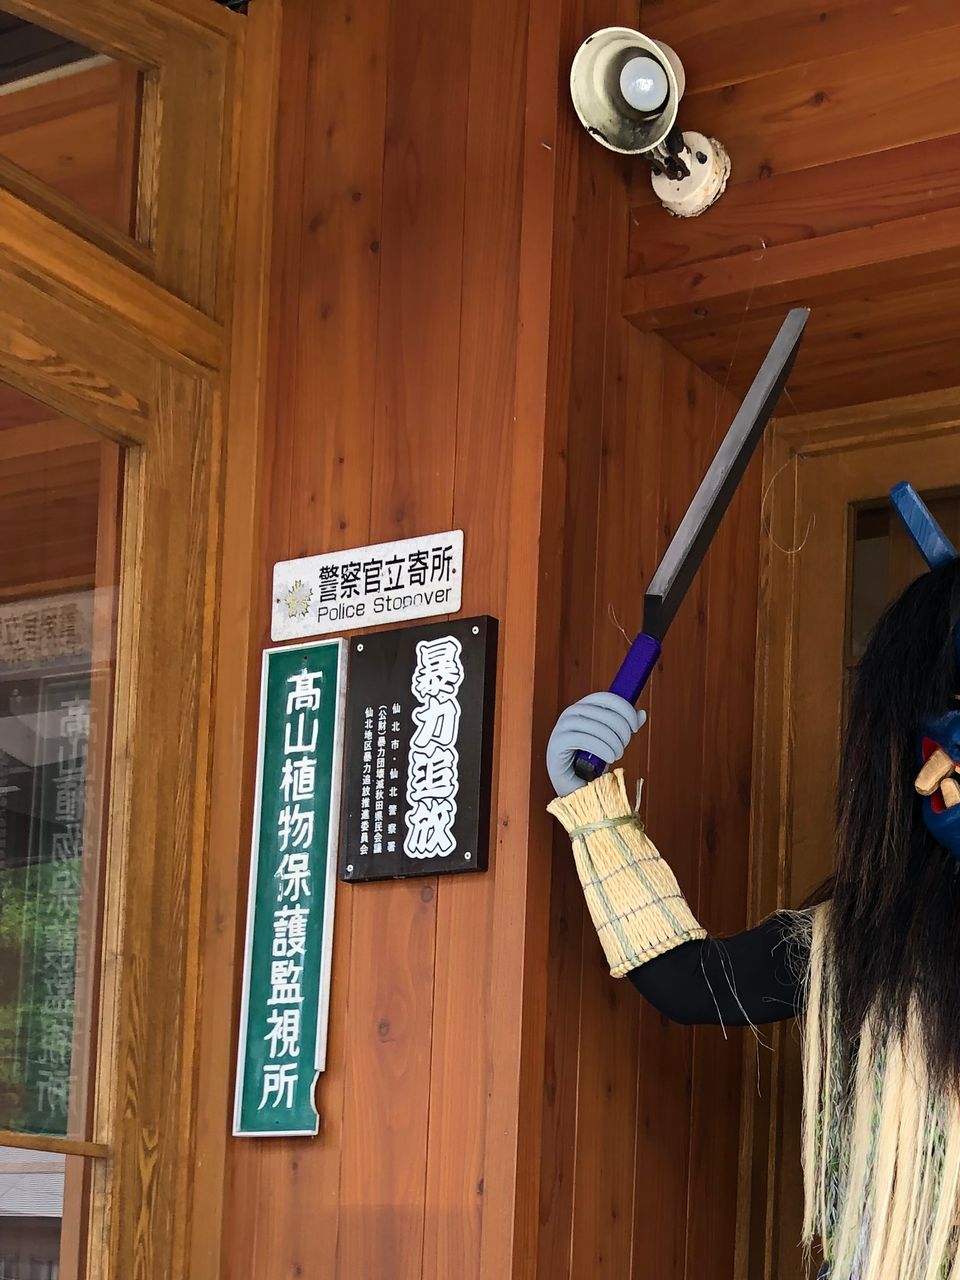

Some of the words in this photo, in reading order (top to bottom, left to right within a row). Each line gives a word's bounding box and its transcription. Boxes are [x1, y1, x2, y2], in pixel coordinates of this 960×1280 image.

[319, 545, 453, 602] 警察官立寄所
[318, 603, 365, 623] Police
[406, 637, 462, 858] 暴力追放
